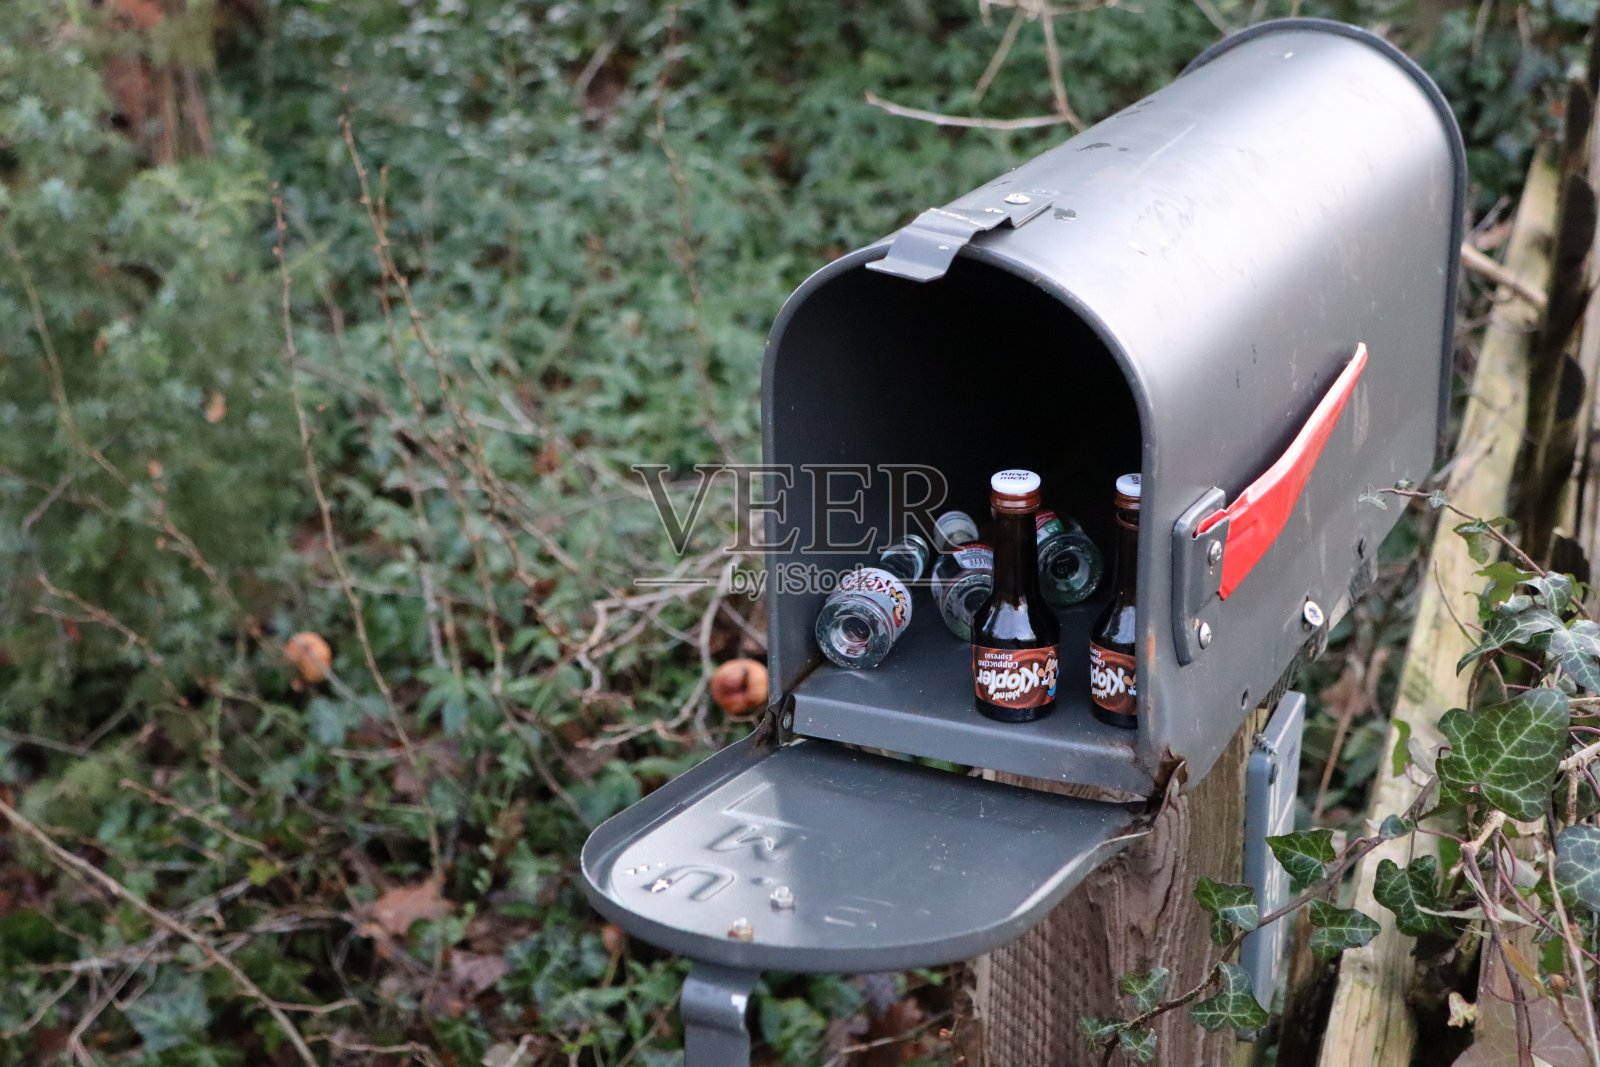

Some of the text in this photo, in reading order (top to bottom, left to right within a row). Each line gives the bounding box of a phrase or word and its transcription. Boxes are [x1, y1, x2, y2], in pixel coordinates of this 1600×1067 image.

[978, 660, 1019, 670] Cappuccino
[985, 653, 1013, 661] Espresso
[977, 662, 1039, 695] Klopfer
[1090, 664, 1125, 696] Klop
